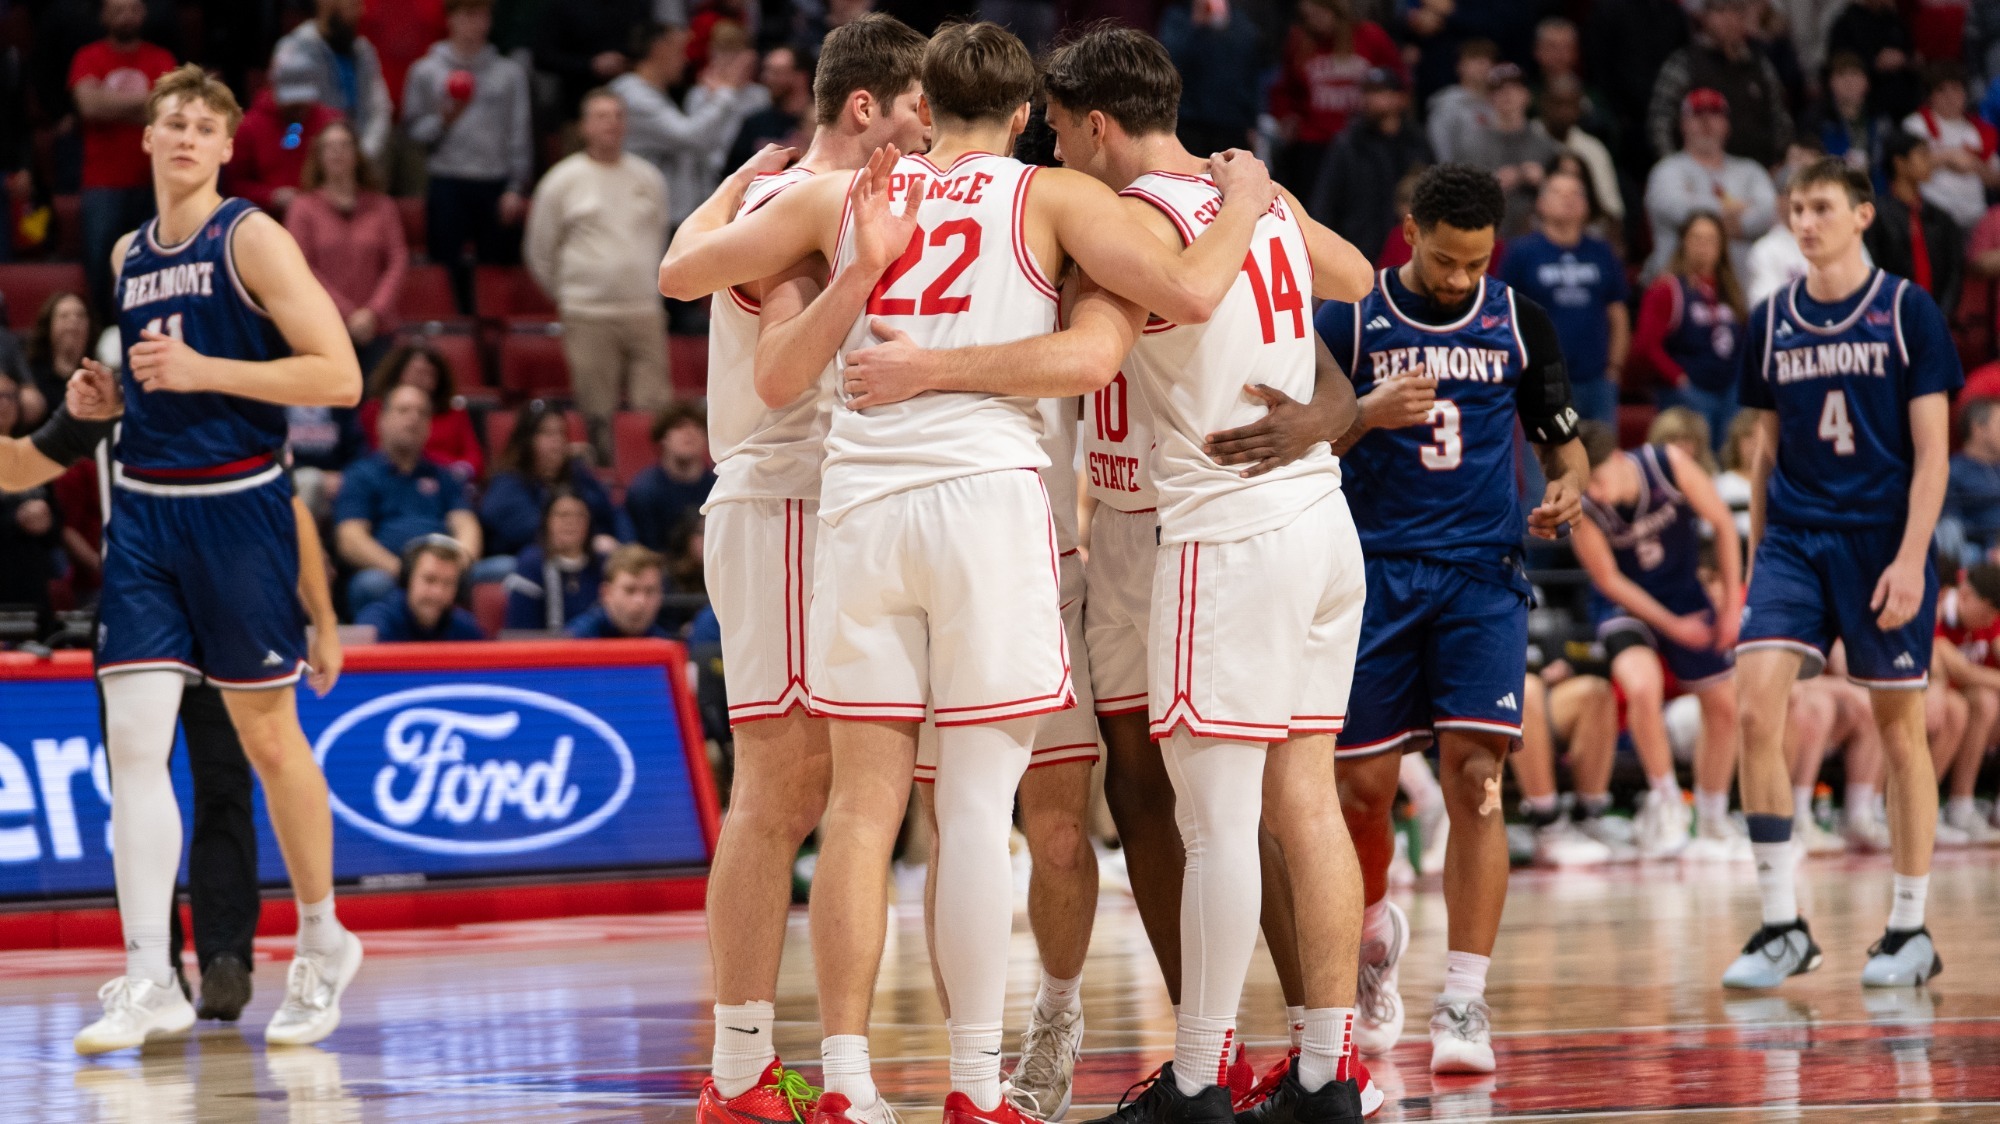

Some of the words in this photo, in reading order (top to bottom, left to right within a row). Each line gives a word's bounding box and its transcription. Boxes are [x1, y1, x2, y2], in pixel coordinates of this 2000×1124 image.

[122, 262, 214, 311] BELMONT
[865, 217, 982, 316] 22
[1241, 237, 1305, 344] 14
[1370, 346, 1509, 384] BELMONT
[1775, 342, 1889, 386] BELMONT
[1094, 370, 1128, 443] 10
[1420, 399, 1463, 470] 3
[1818, 389, 1856, 456] 4
[1089, 451, 1141, 493] STATE
[373, 706, 581, 826] Ford
